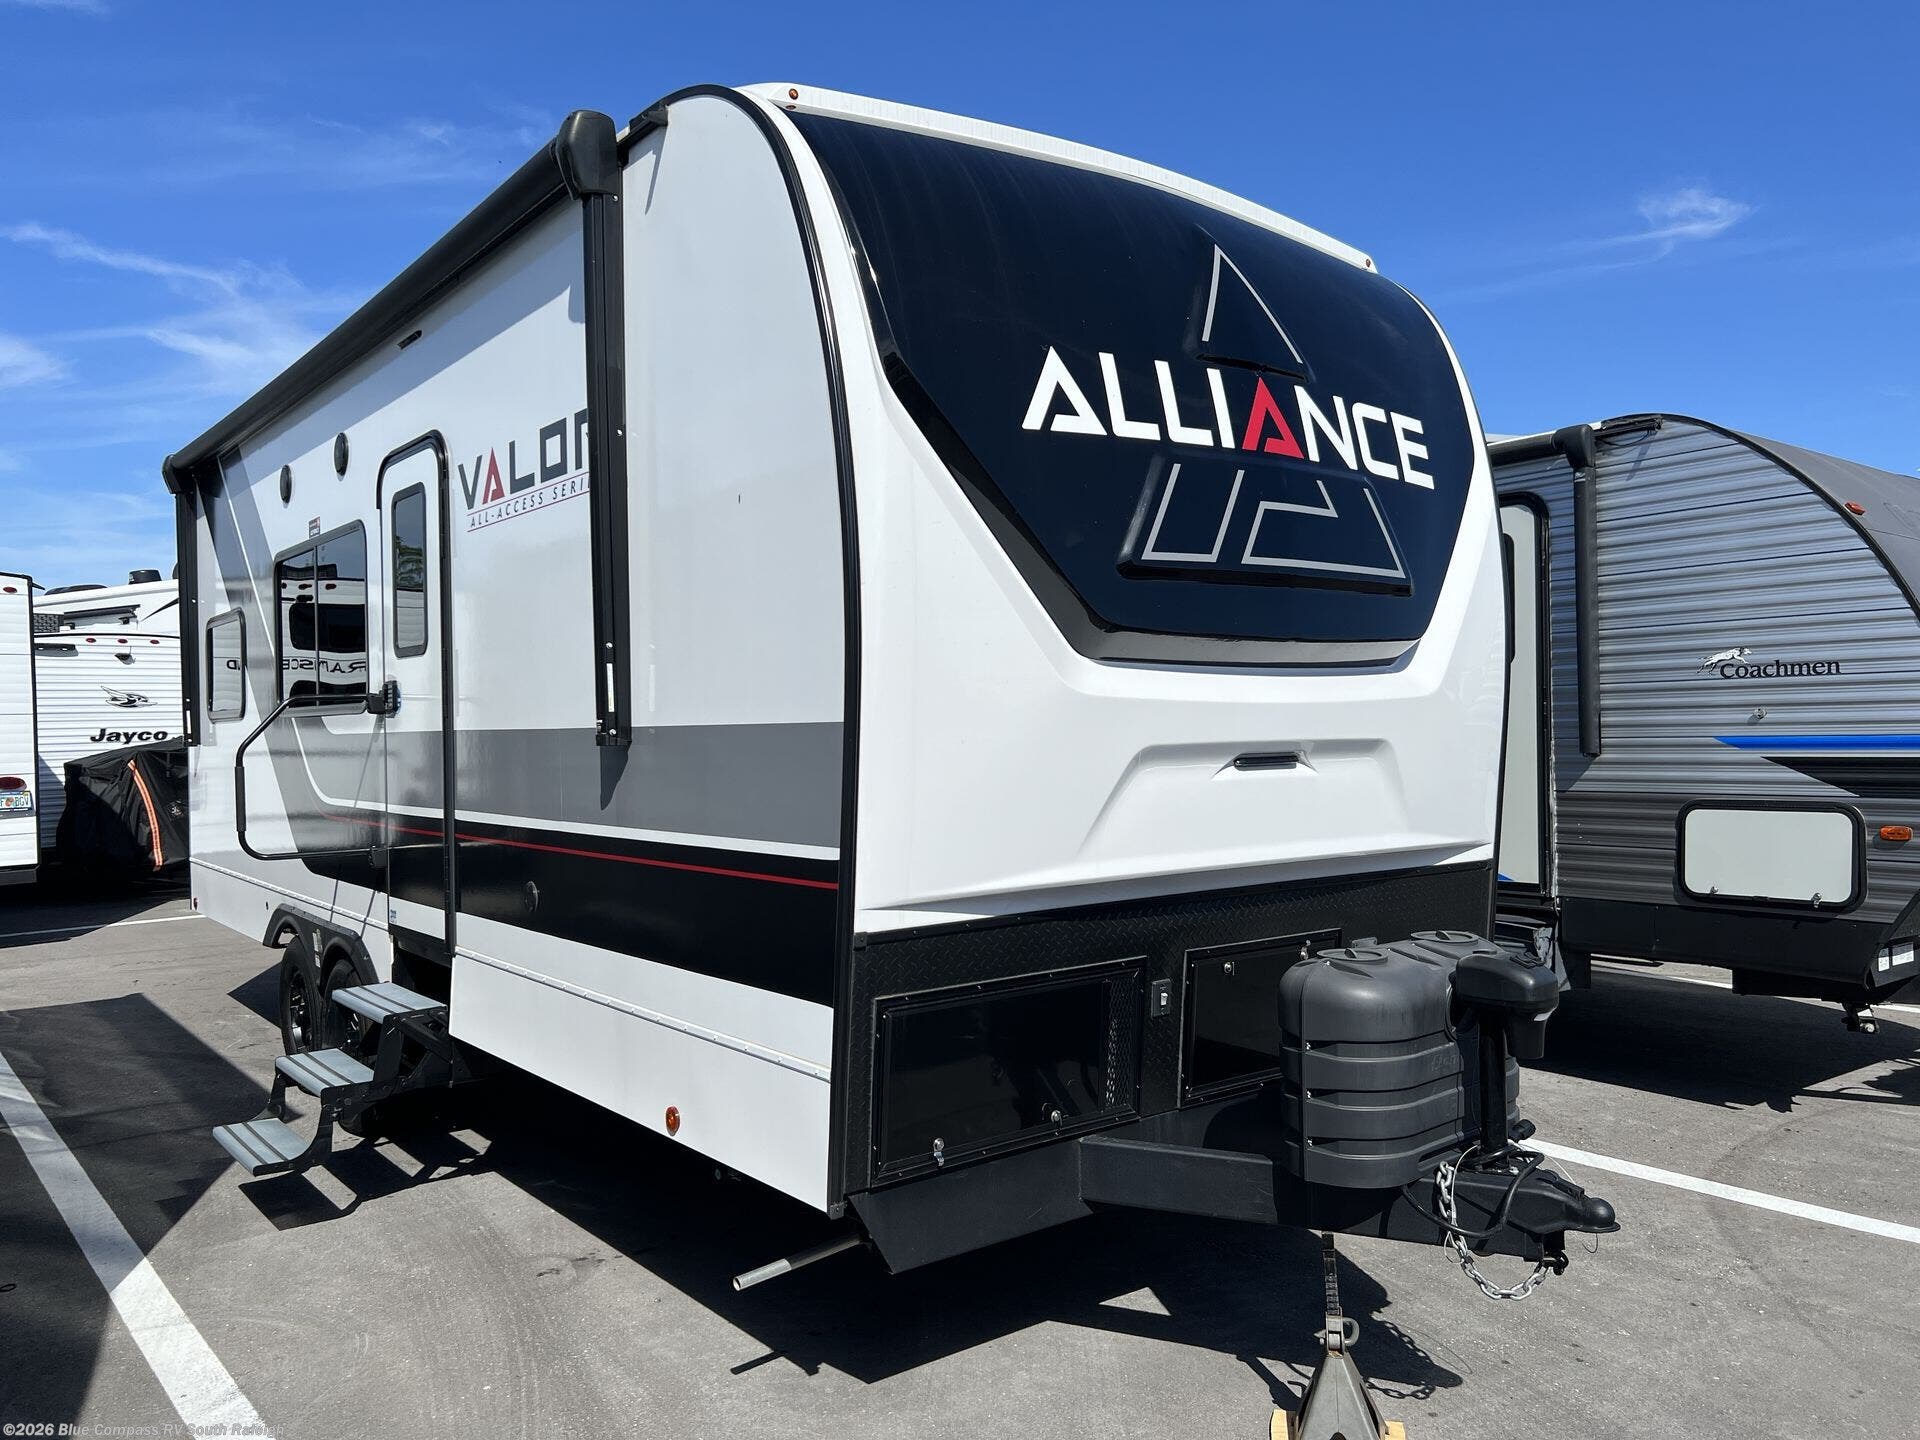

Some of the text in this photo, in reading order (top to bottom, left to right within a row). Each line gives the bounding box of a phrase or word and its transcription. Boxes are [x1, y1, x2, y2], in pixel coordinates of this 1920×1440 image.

[1021, 345, 1435, 490] ALLIANCE
[470, 476, 590, 528] ALL-ACCESS SERI
[1720, 659, 1842, 679] Coachmen
[90, 728, 169, 745] Jayco
